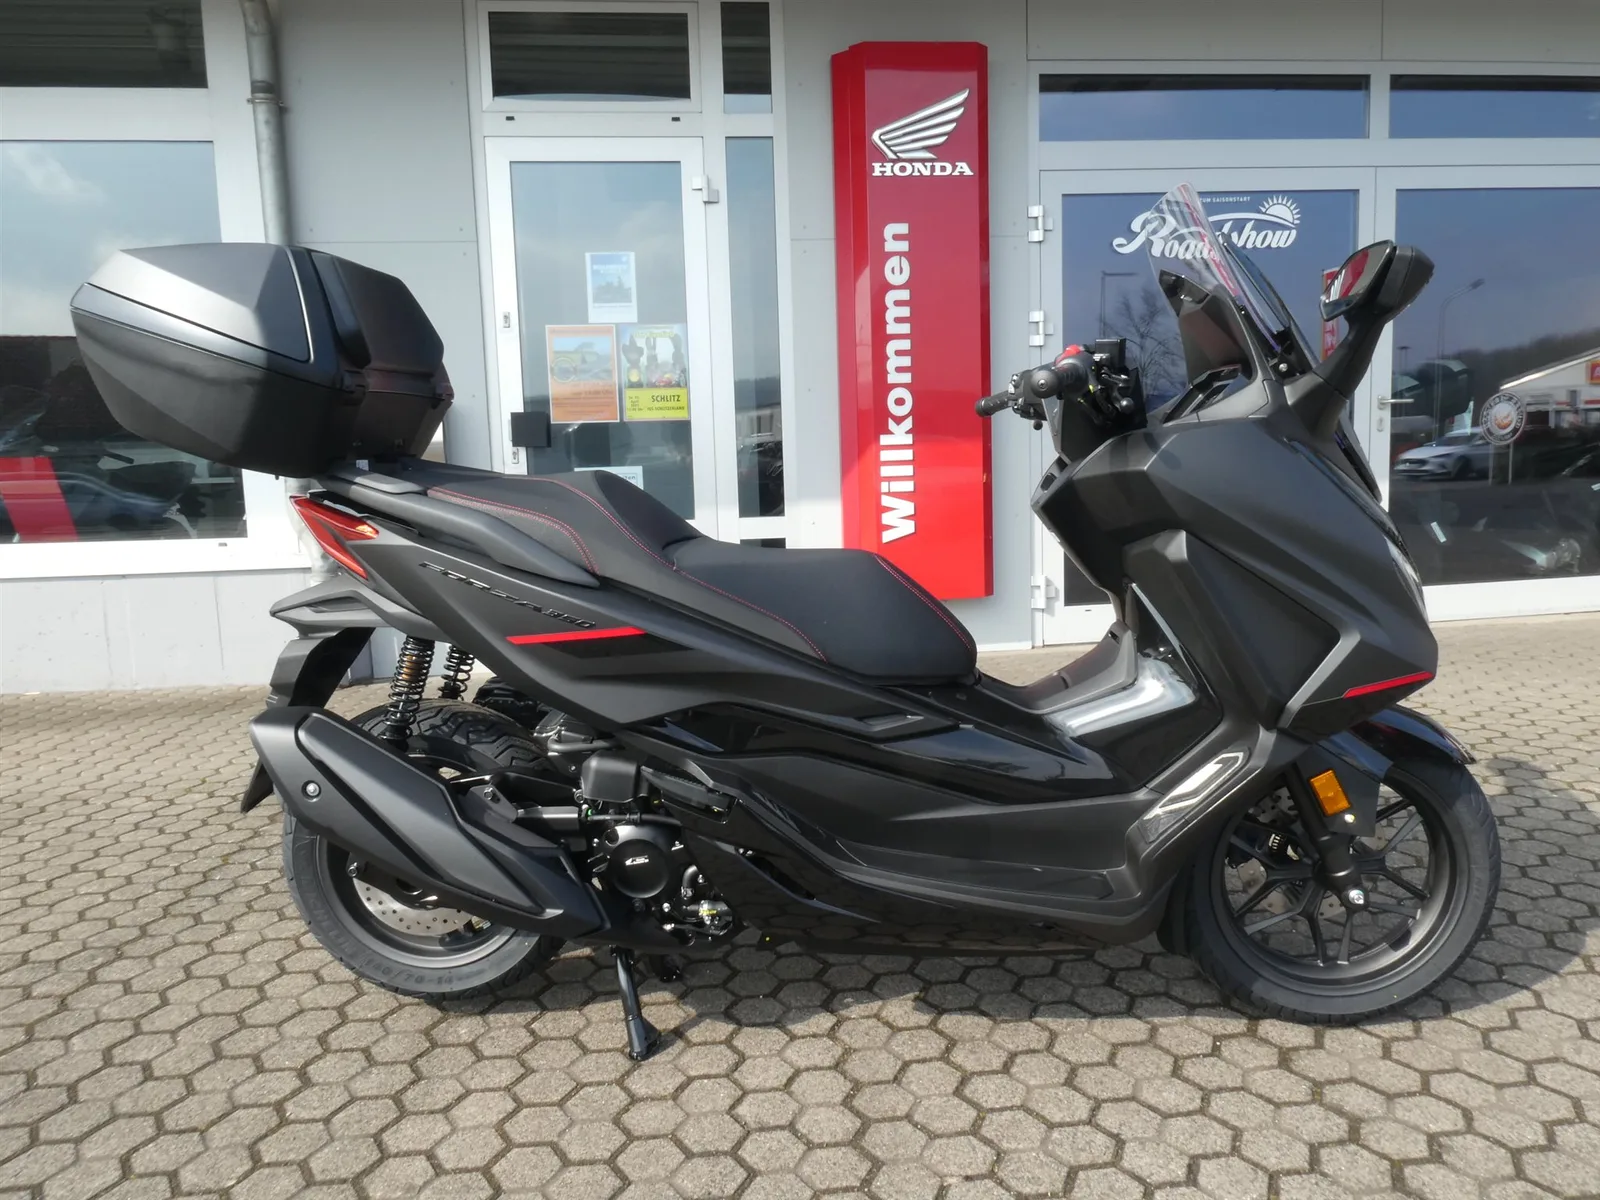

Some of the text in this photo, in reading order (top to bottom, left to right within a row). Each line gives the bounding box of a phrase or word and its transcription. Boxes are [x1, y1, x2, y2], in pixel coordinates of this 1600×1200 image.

[872, 162, 974, 176] HONDA
[880, 222, 916, 544] Willkommen
[651, 394, 682, 403] SCHLITZ
